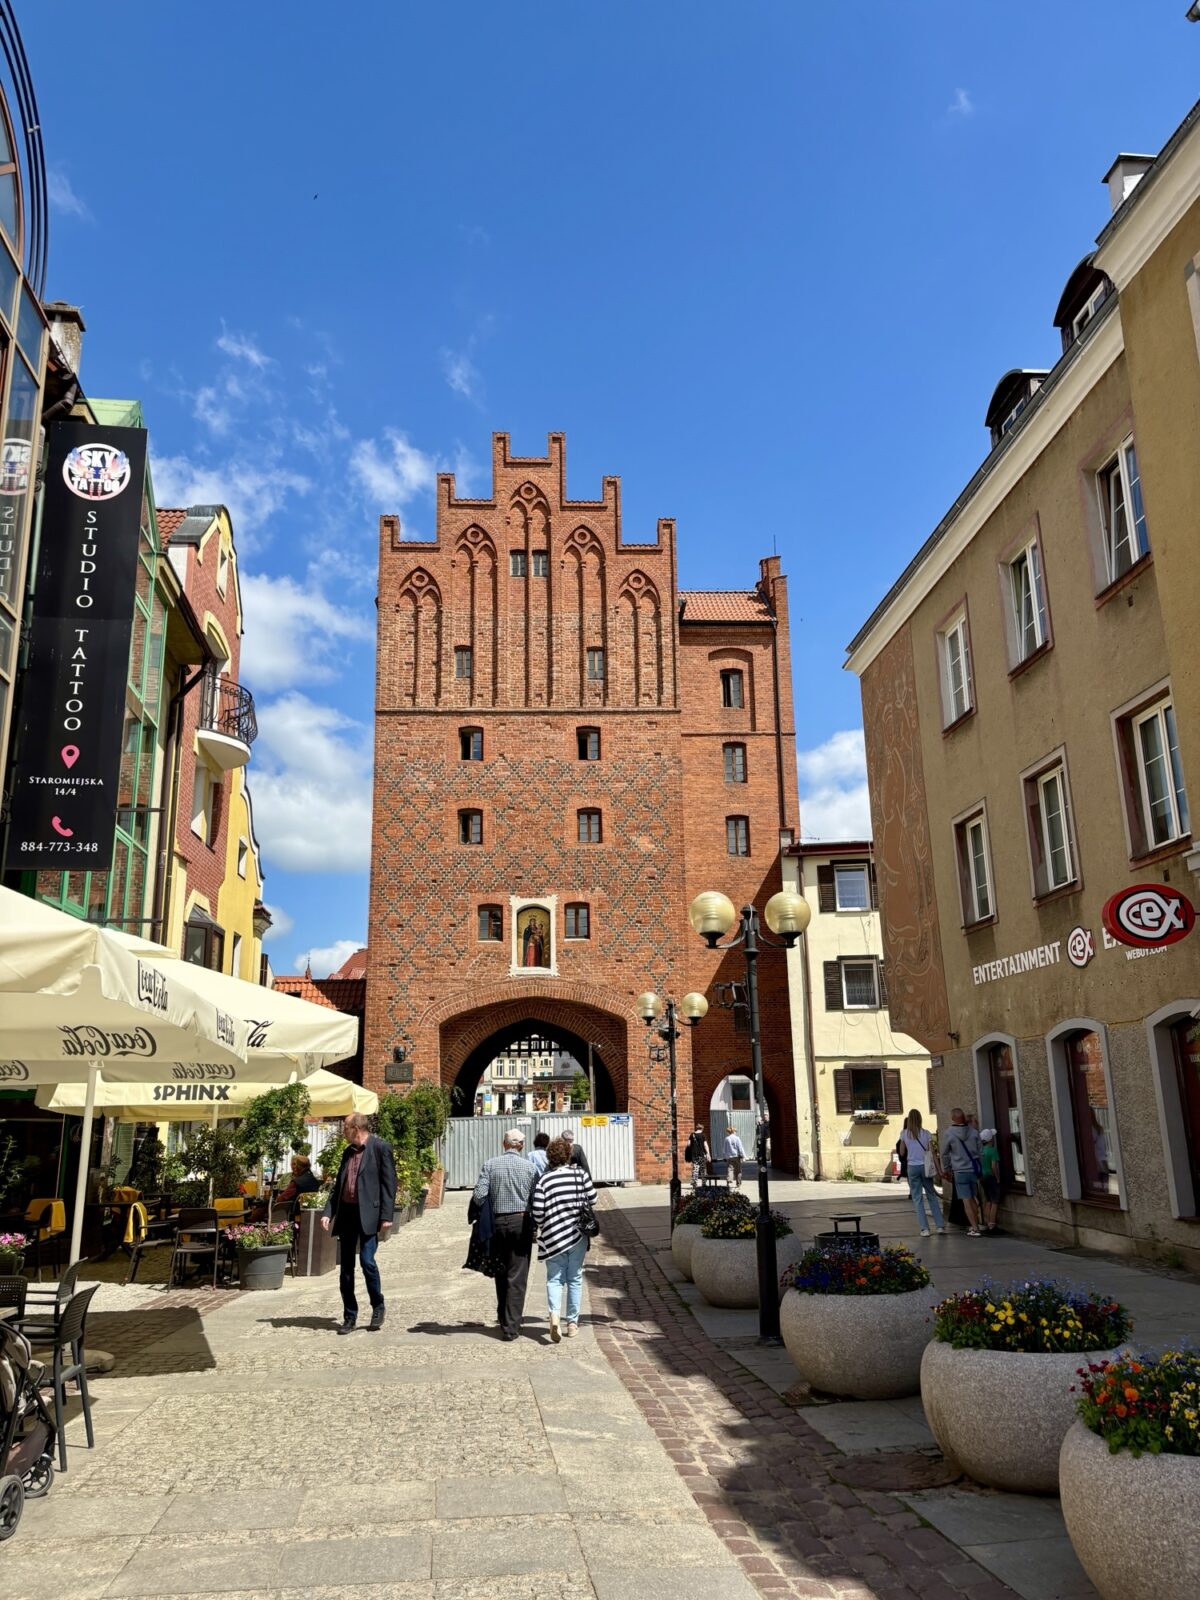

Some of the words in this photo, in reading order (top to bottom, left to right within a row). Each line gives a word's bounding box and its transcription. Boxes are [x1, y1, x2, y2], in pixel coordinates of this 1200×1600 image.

[80, 450, 117, 468] SKY
[71, 477, 121, 493] TATTOO
[75, 510, 98, 608] STUDIO
[63, 629, 89, 731] TATTOO
[28, 775, 104, 786] STAROMIEJSKA
[54, 787, 77, 796] 14/4
[20, 841, 99, 852] 884-773-348
[972, 941, 1062, 985] ENTERTAINMENT
[152, 1084, 231, 1101] SPHINX
